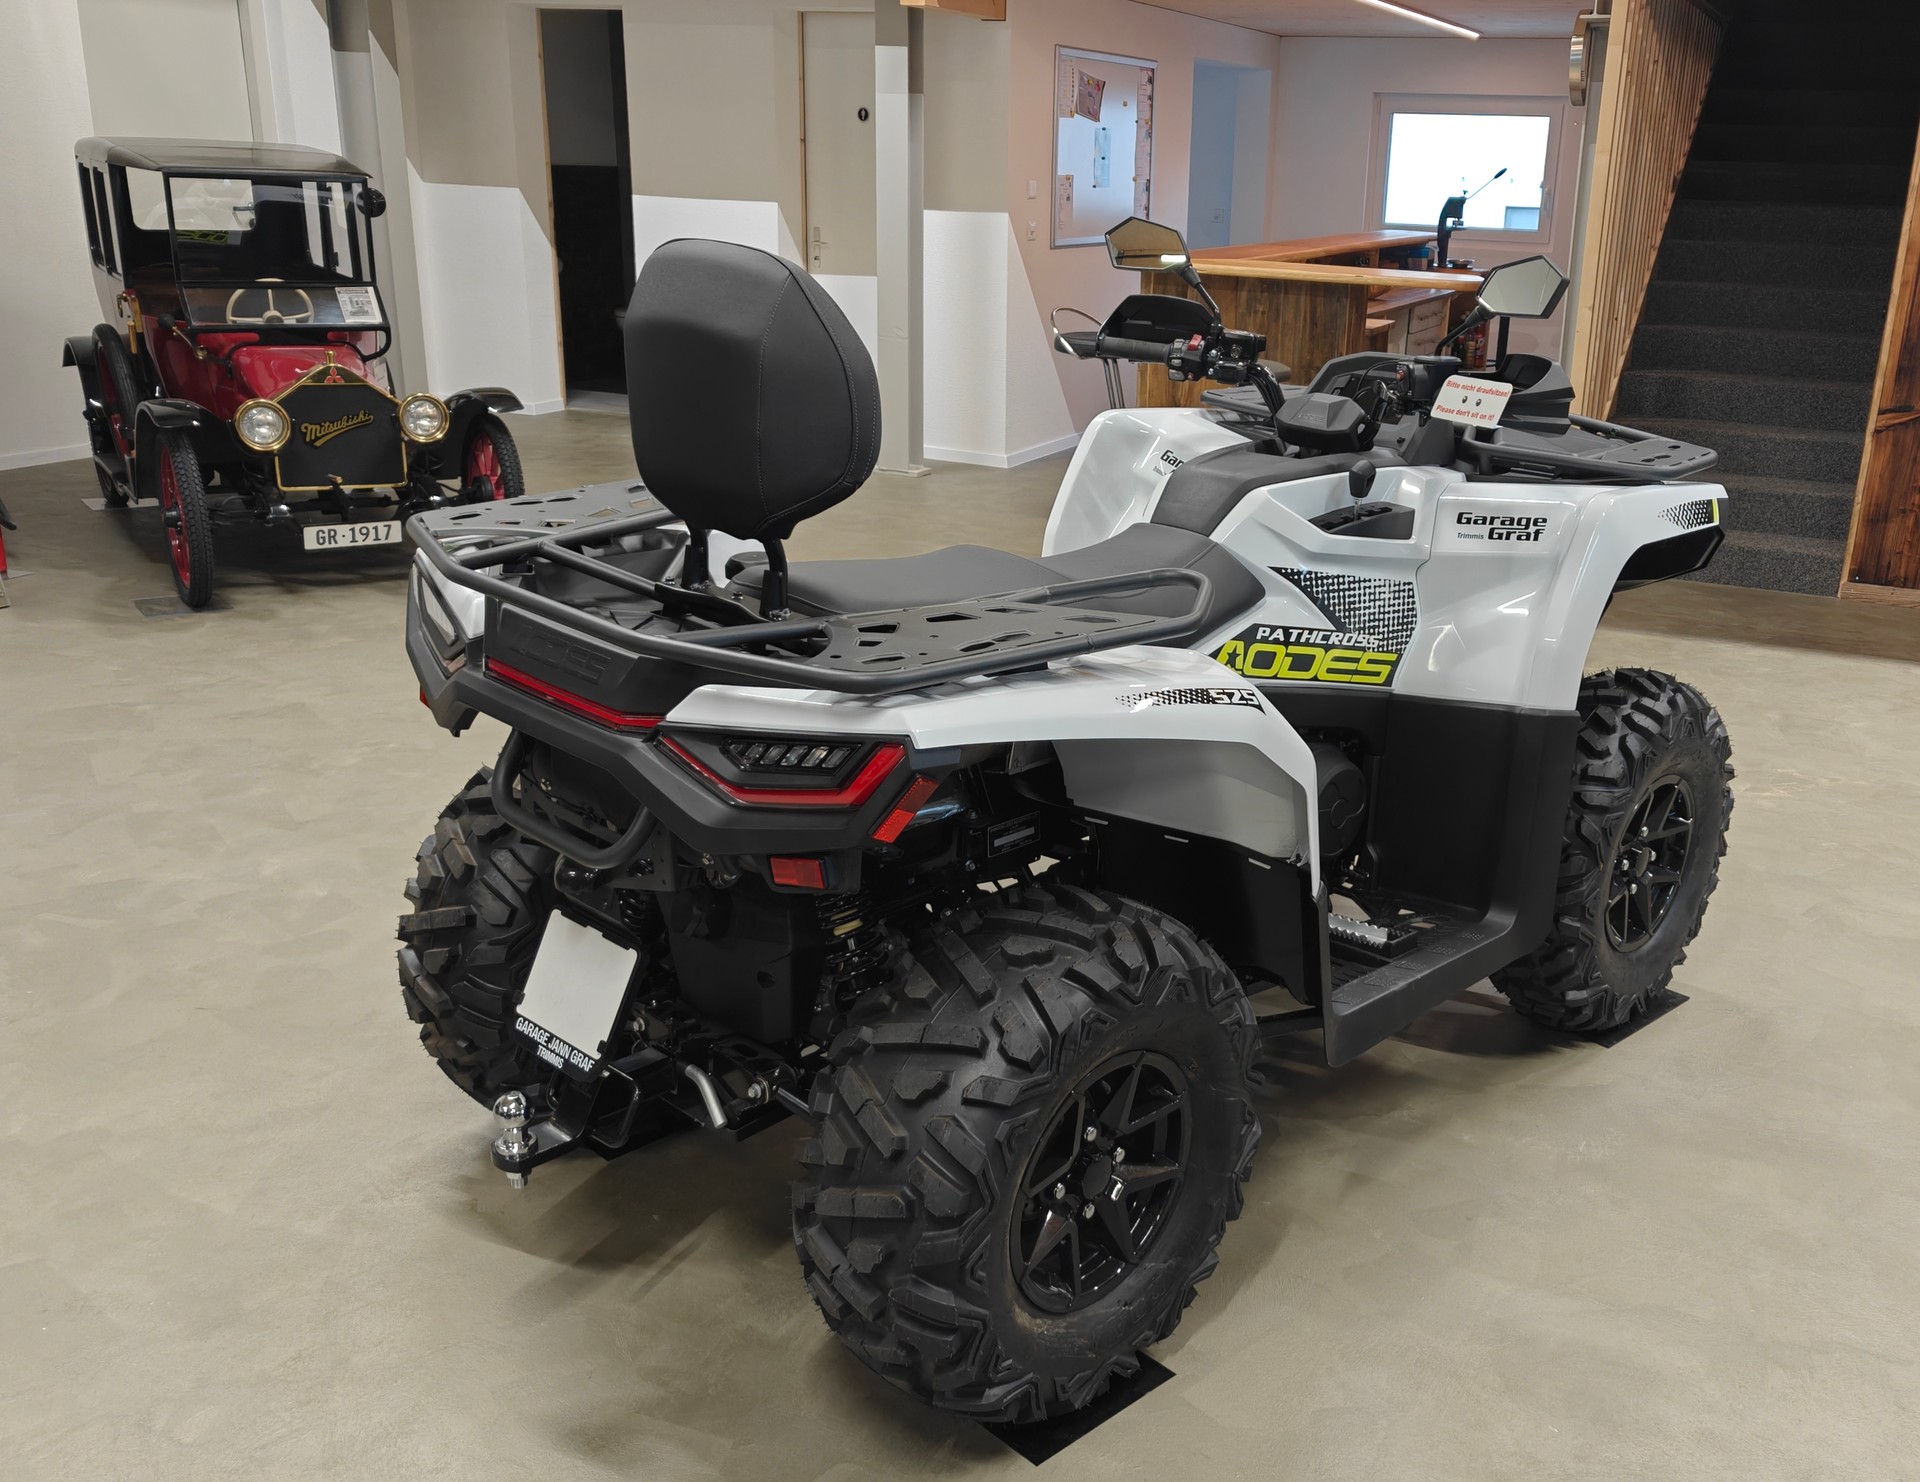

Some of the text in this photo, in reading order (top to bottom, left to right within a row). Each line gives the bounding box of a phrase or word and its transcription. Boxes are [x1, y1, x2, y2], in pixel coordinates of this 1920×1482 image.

[1446, 380, 1510, 398] Bitte nicht draufsitzen!
[1436, 404, 1455, 415] Please
[1456, 408, 1470, 417] don't
[1470, 411, 1479, 419] sit
[301, 410, 373, 447] Mitsubishi
[1159, 449, 1184, 468] Gar
[1456, 511, 1548, 531] Garage
[1457, 532, 1484, 540] Trimmis
[1488, 527, 1545, 542] Graf
[1256, 626, 1379, 648] PATHCROSS
[1216, 640, 1398, 684] AODES
[1207, 689, 1260, 705] 525
[515, 1017, 595, 1072] GARAGE JANN GRAF
[536, 1044, 565, 1069] TRIMMIS
